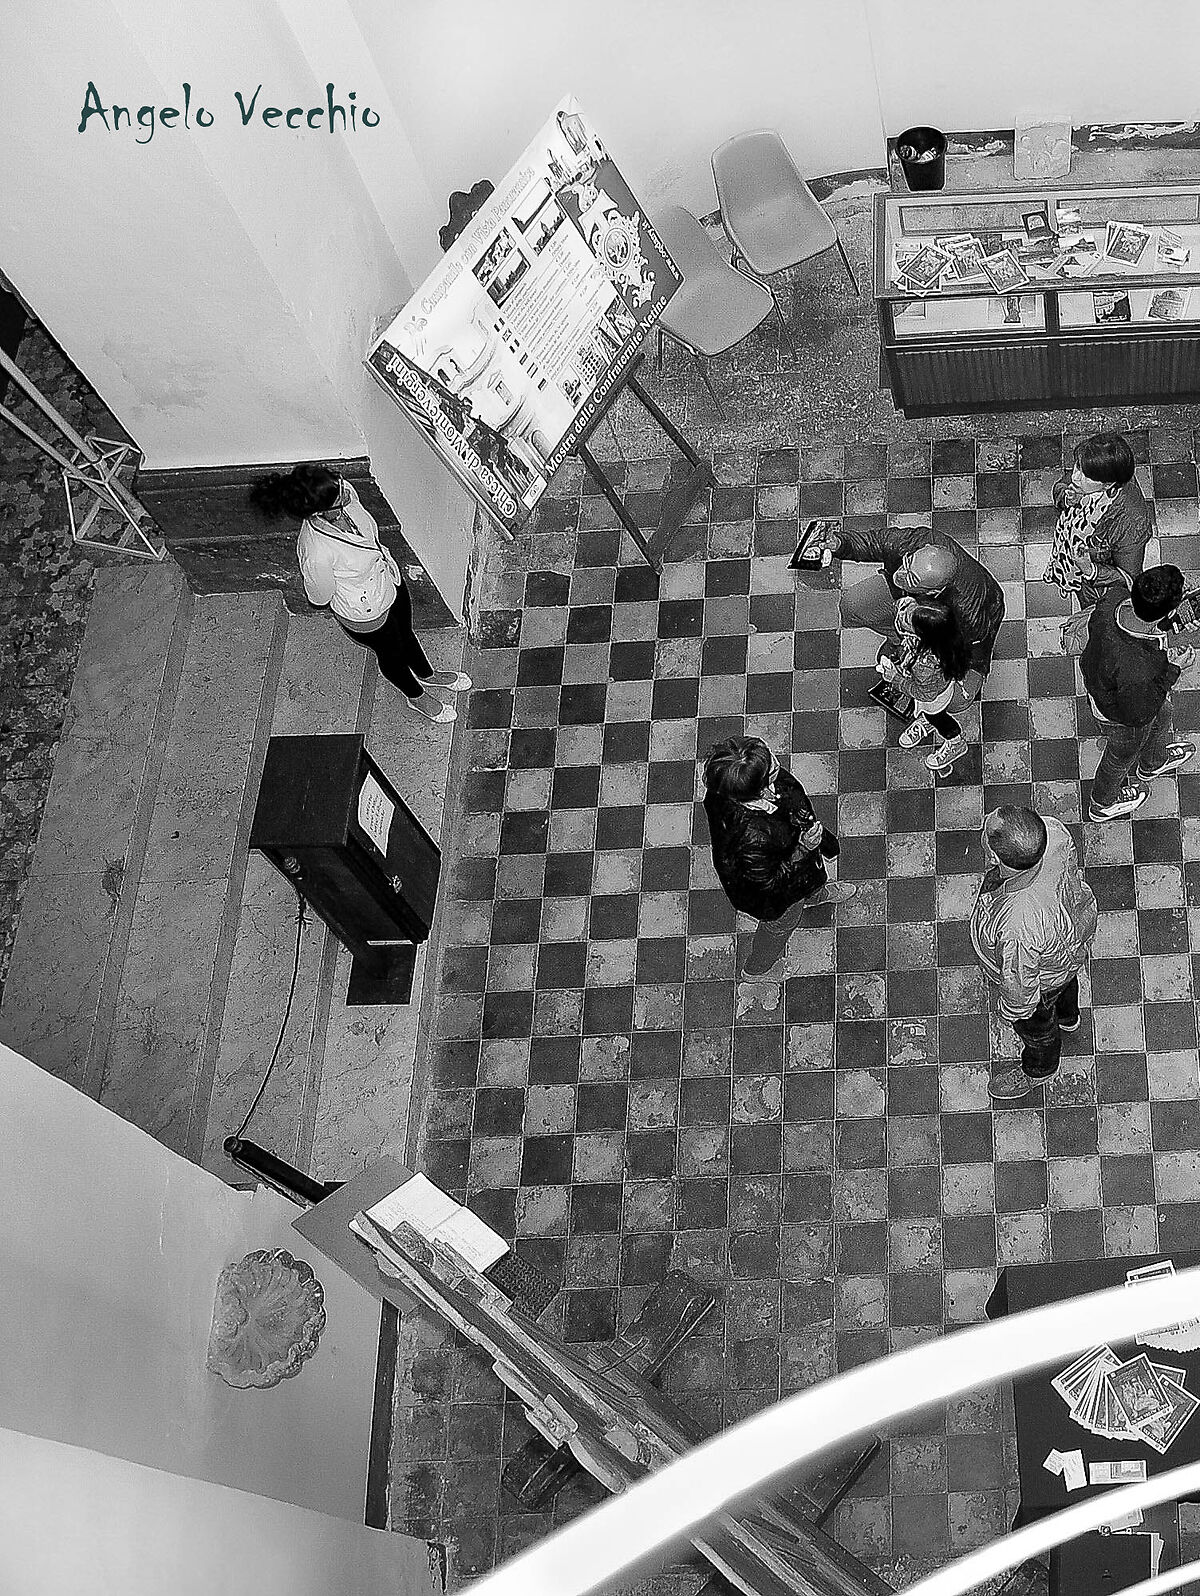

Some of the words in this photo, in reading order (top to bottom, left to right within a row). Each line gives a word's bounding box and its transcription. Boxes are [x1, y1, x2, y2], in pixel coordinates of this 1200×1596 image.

[470, 217, 498, 245] Vista
[387, 353, 470, 455] Montevergini
[544, 433, 577, 476] Mostra
[573, 402, 596, 434] delle
[592, 331, 644, 405] Confraternite
[640, 296, 668, 333] Netine
[463, 448, 481, 468] di
[478, 464, 517, 519] Chiesa
